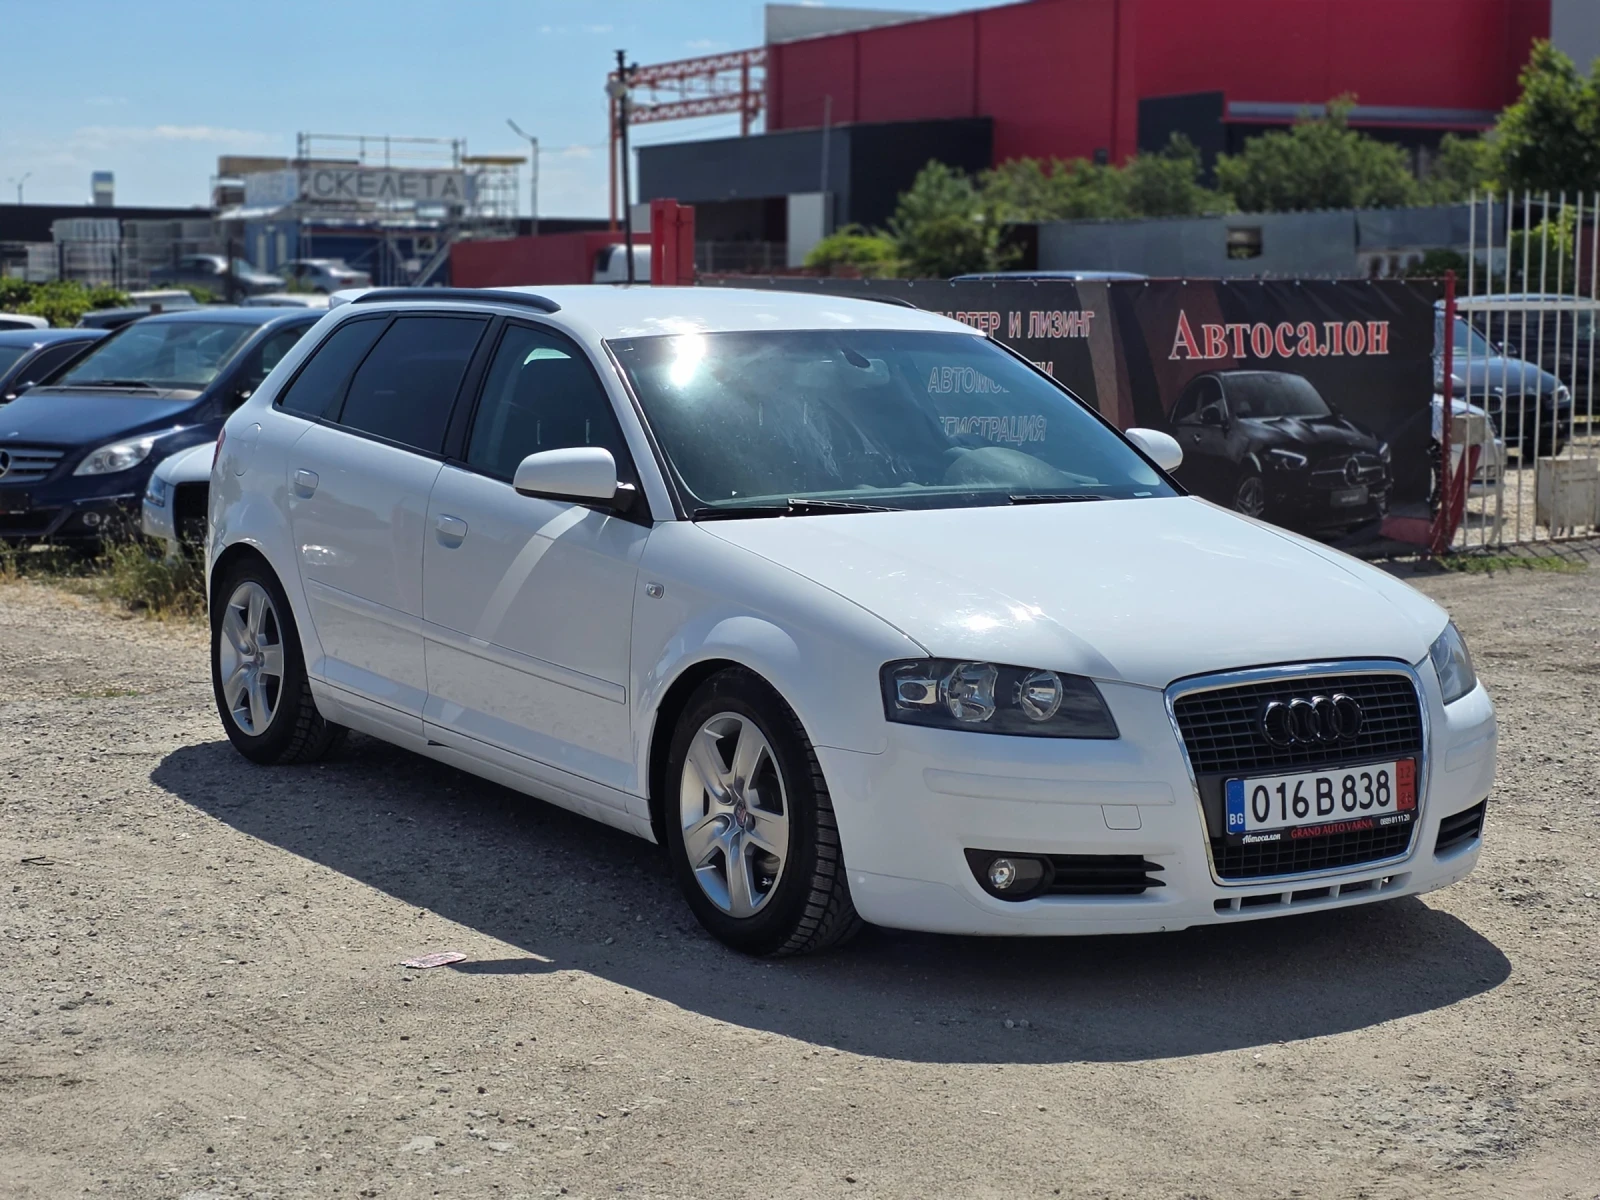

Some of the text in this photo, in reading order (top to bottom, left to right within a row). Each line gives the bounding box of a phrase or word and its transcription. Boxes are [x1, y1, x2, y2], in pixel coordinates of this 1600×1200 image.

[1009, 311, 1021, 338] И
[1028, 311, 1095, 338] ЛИЗИНГ
[1168, 309, 1389, 359] Автосалон
[940, 414, 1047, 446] ГИСТРАЦИЯ
[1229, 813, 1244, 825] BG
[1290, 818, 1374, 839] GRAND AUTO VARNA
